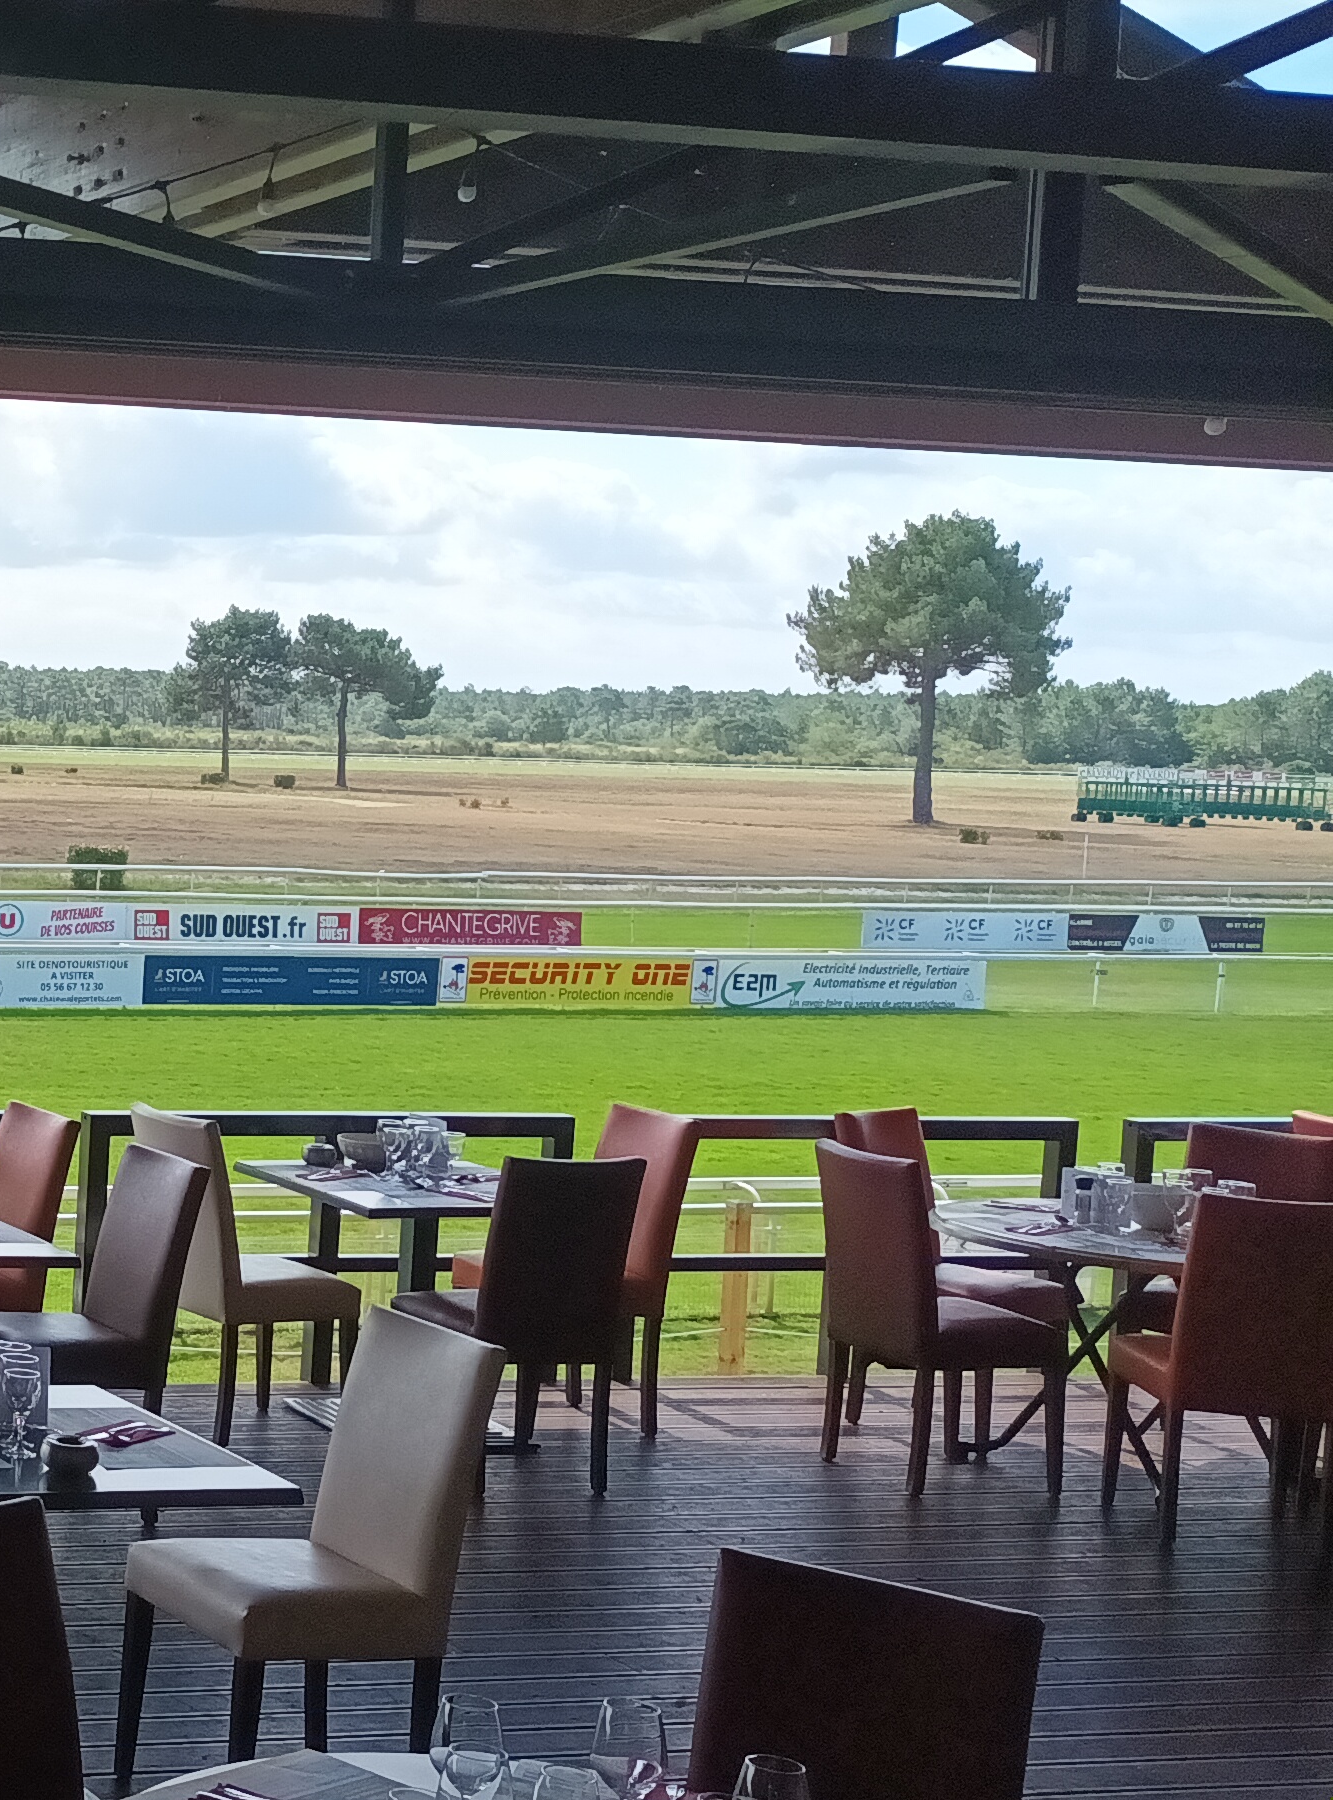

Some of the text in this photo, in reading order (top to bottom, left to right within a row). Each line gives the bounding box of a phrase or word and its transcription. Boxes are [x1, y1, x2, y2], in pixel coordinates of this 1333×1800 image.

[0, 912, 16, 928] U
[50, 907, 105, 921] PARTENAIRE
[136, 912, 157, 925] SUD
[319, 915, 339, 927] SUD
[40, 920, 115, 938] DE VOS COURSES
[180, 913, 307, 939] SUD OUEST.fr
[401, 911, 542, 936] CHANTEGRIVE
[899, 918, 916, 930] CF
[968, 918, 986, 930] CF
[1037, 919, 1054, 931] CF
[136, 925, 168, 938] OUEST
[319, 927, 349, 940] OUEST
[16, 960, 129, 970] SITE OENOTOURISTIQUE
[803, 962, 970, 976] Electricité Tertiaire
[51, 971, 95, 980] A VISITER
[165, 967, 205, 983] STOA
[389, 970, 428, 986] STOA
[468, 961, 692, 986] SECURITY ONE
[40, 982, 104, 991] 05 56 67 12 30
[813, 977, 958, 992] Automatisme et régulation
[479, 988, 674, 1002] Prévention Protection incendie
